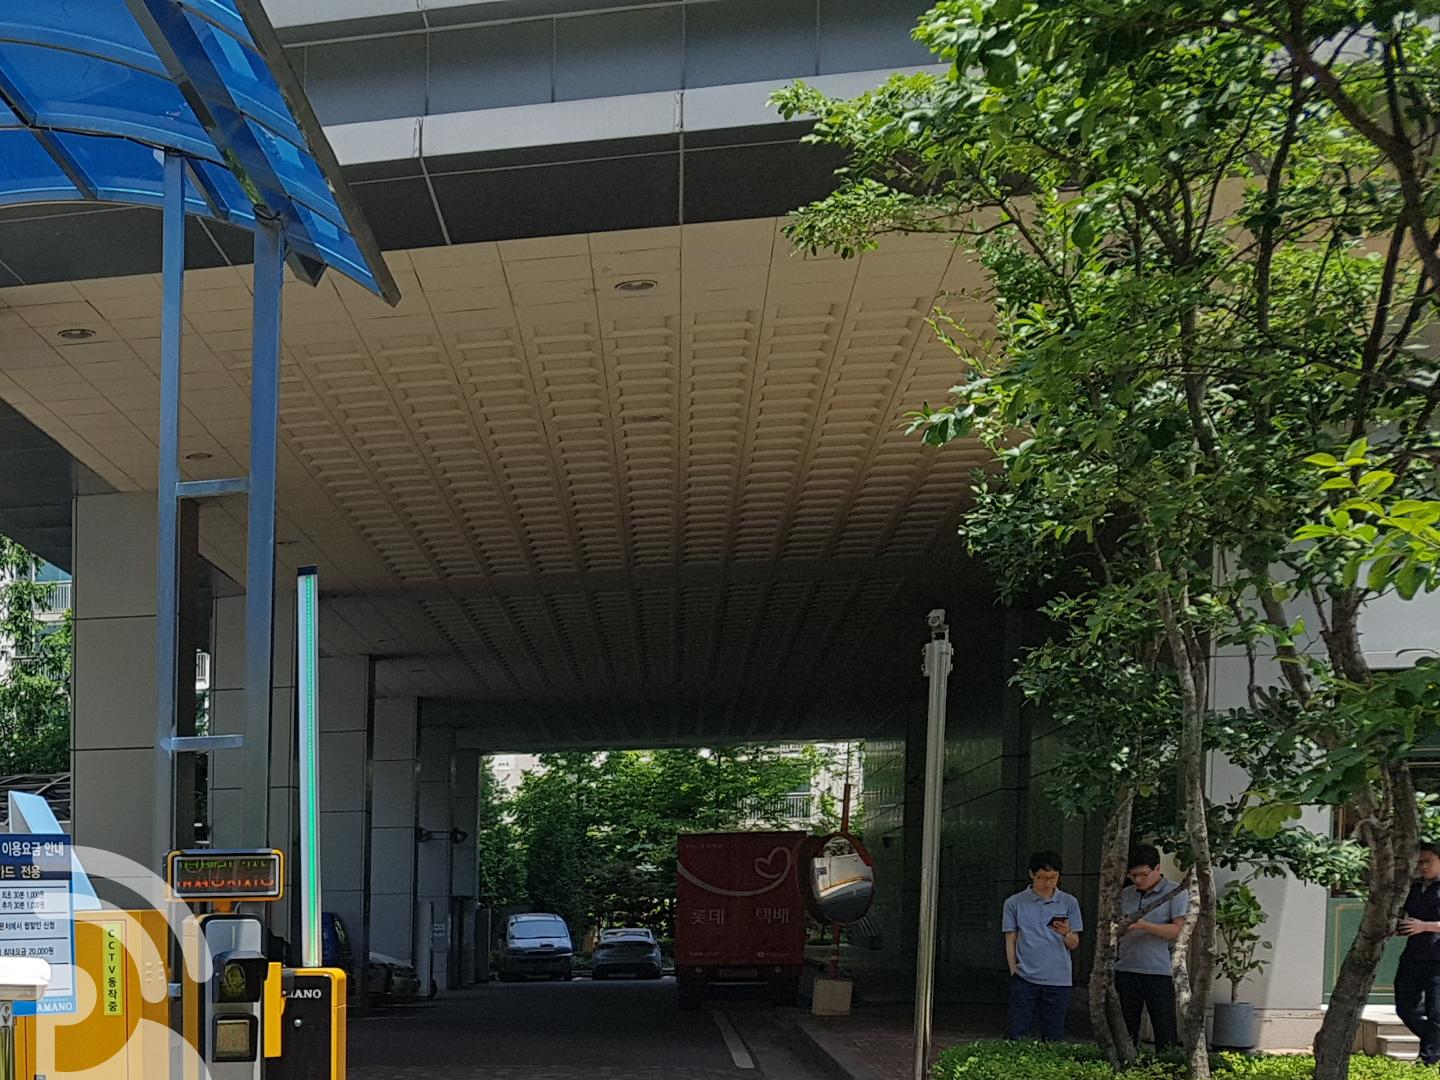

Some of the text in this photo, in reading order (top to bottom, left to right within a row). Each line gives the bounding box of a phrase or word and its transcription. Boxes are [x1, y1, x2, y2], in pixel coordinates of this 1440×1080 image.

[2, 841, 41, 857] 이용요금
[44, 841, 64, 857] 안내
[20, 865, 41, 879] 전용
[13, 891, 25, 899] 30분
[13, 901, 25, 909] 30분
[690, 907, 790, 926] 롯데 택배
[28, 946, 54, 957] 20,000원
[36, 1001, 73, 1012] AMANO
